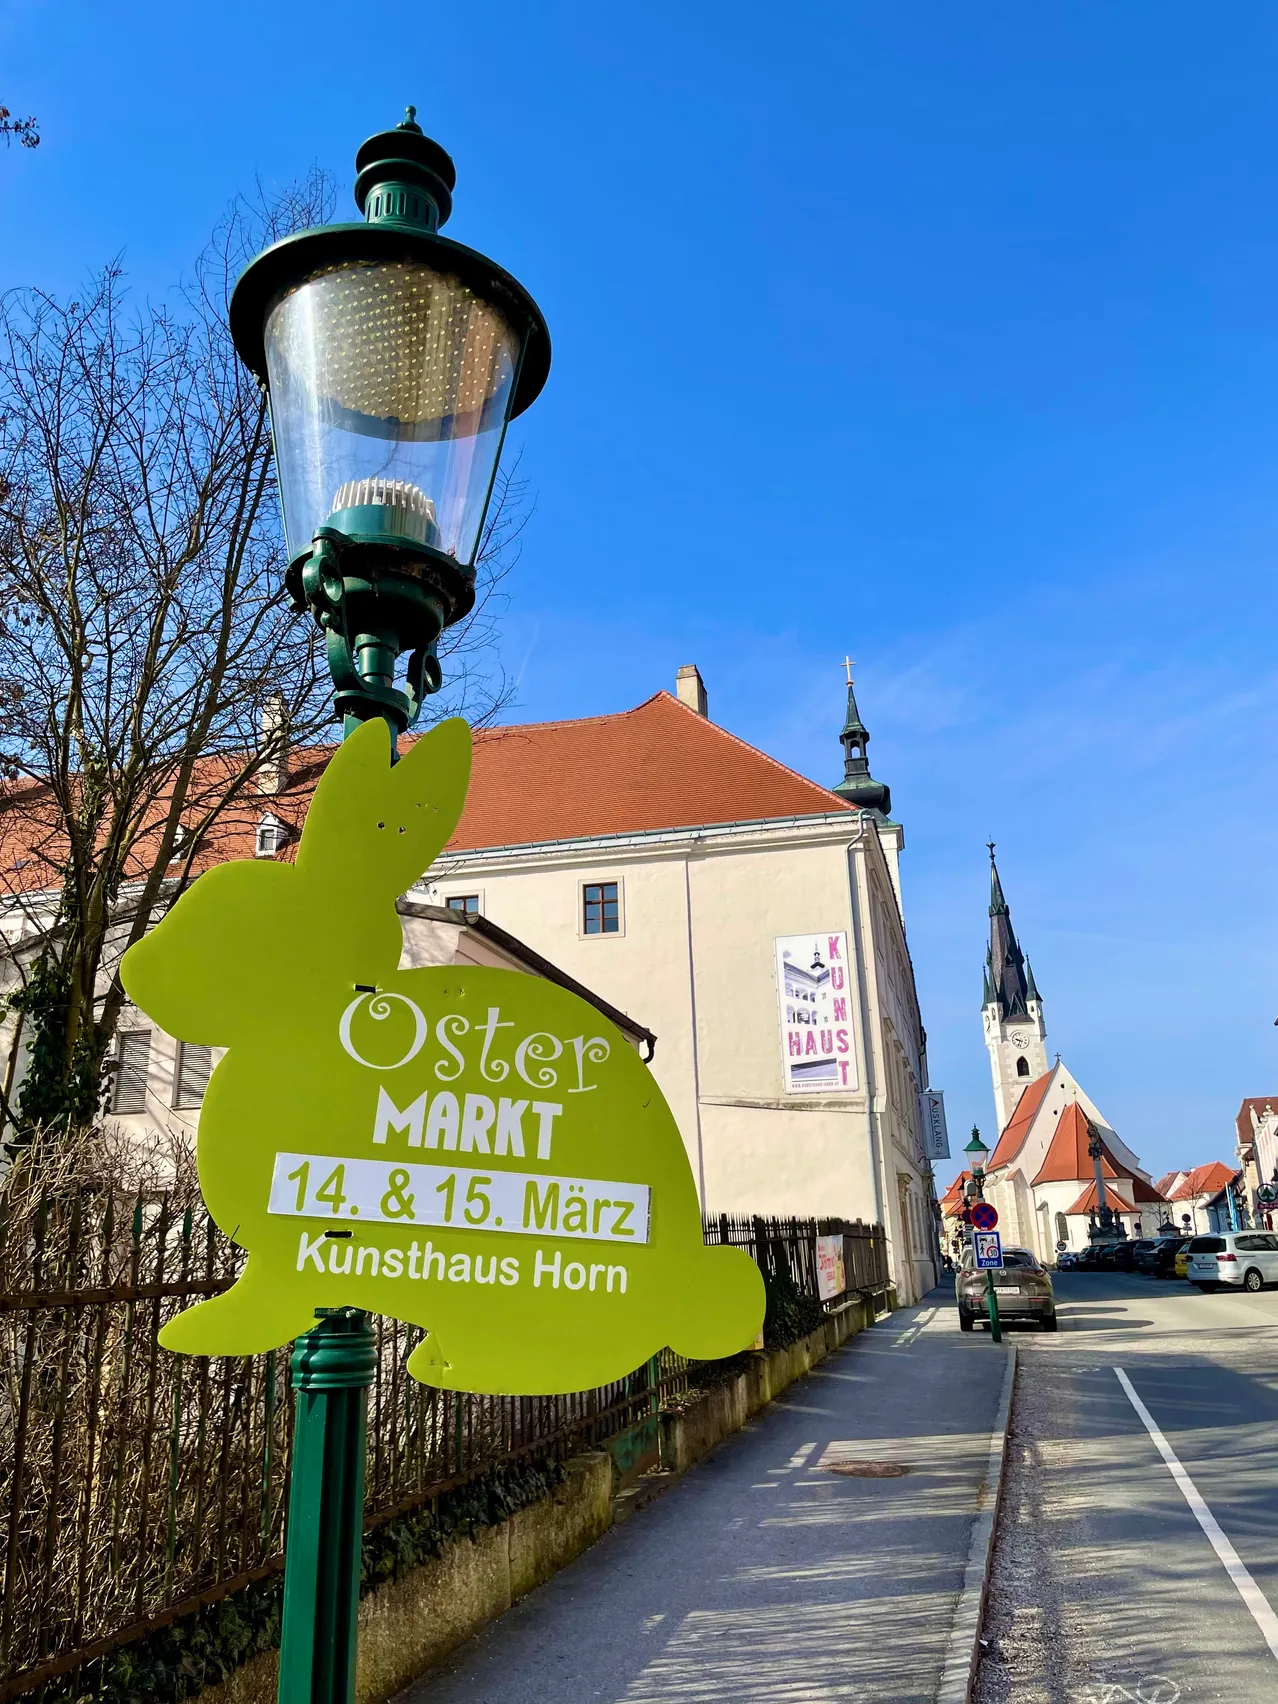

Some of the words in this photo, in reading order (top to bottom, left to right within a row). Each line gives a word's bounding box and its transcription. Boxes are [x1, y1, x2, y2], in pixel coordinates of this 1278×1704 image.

[339, 988, 610, 1093] Oster
[788, 1029, 849, 1056] HAUS
[828, 936, 850, 1085] KUNST
[372, 1085, 562, 1160] MARKT
[928, 1097, 943, 1148] AUSKLANG
[287, 1161, 359, 1216] 14.
[380, 1168, 416, 1220] &
[435, 1174, 502, 1227] 15.
[522, 1180, 635, 1236] März
[296, 1232, 520, 1286] Kunsthaus
[533, 1250, 627, 1294] Horn
[990, 1249, 998, 1257] 30
